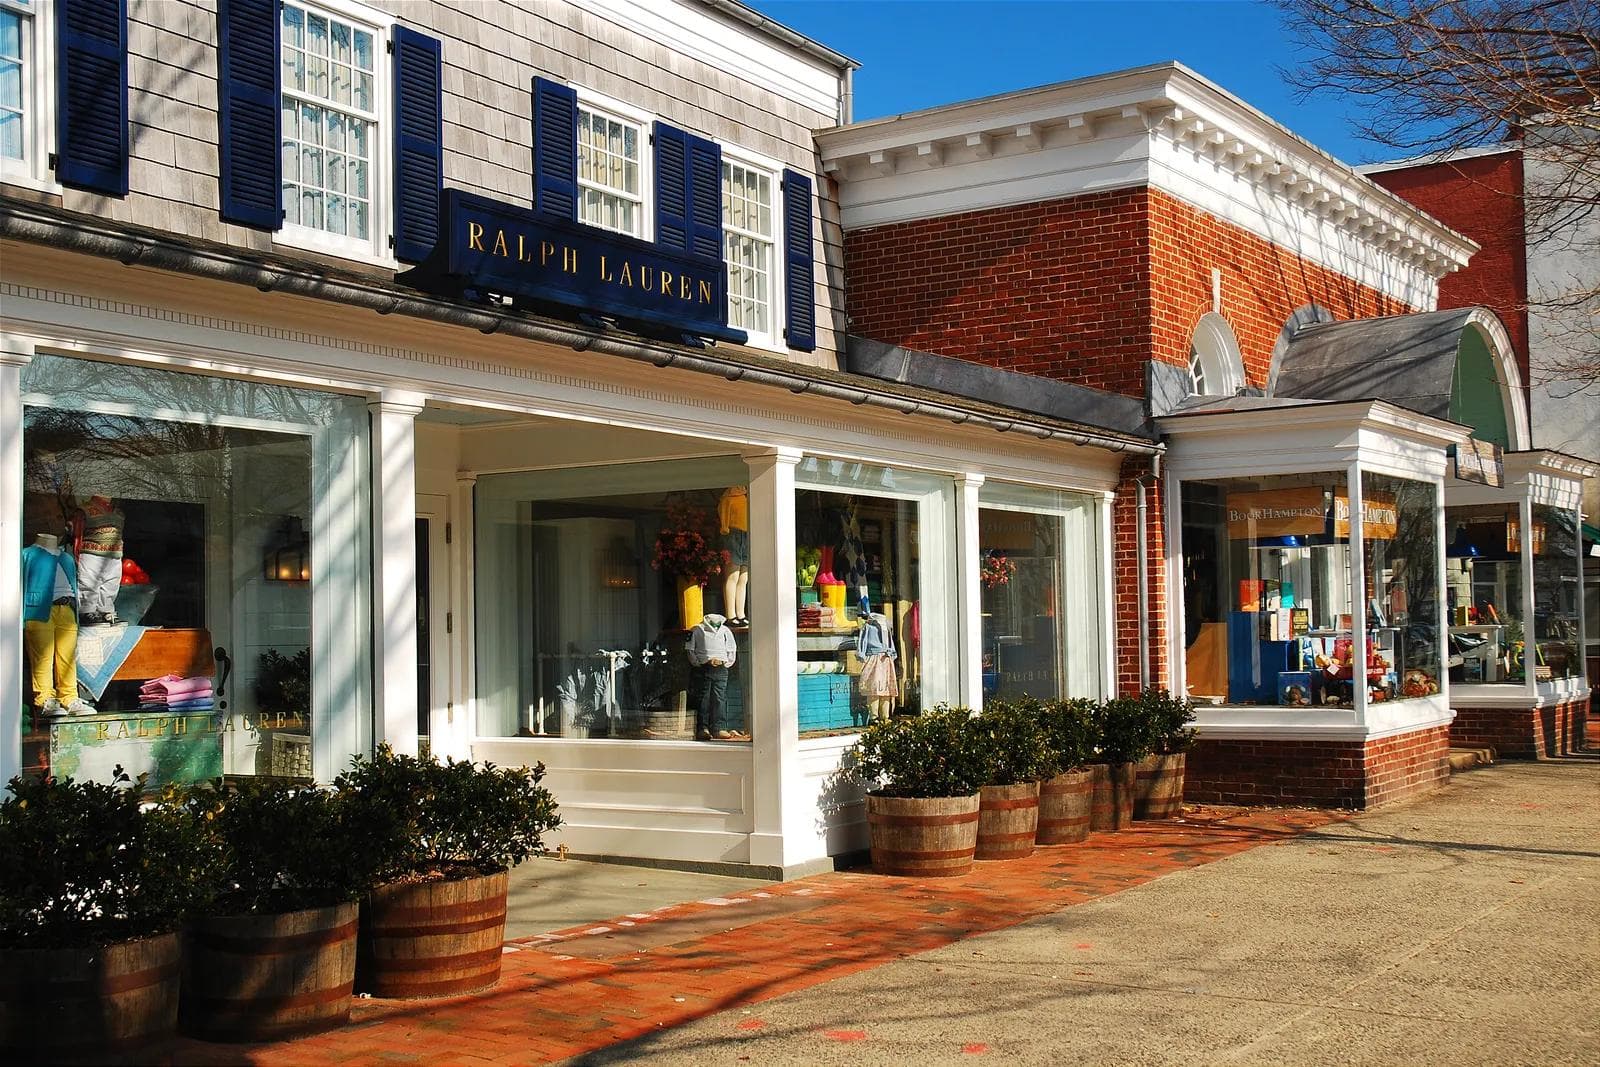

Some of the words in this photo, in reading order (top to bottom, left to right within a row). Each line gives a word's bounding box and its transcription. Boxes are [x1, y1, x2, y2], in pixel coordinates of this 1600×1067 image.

[468, 221, 577, 274] RALPH
[600, 256, 712, 305] LAUREN
[96, 716, 188, 741] RALPH
[207, 711, 304, 734] LAUREN
